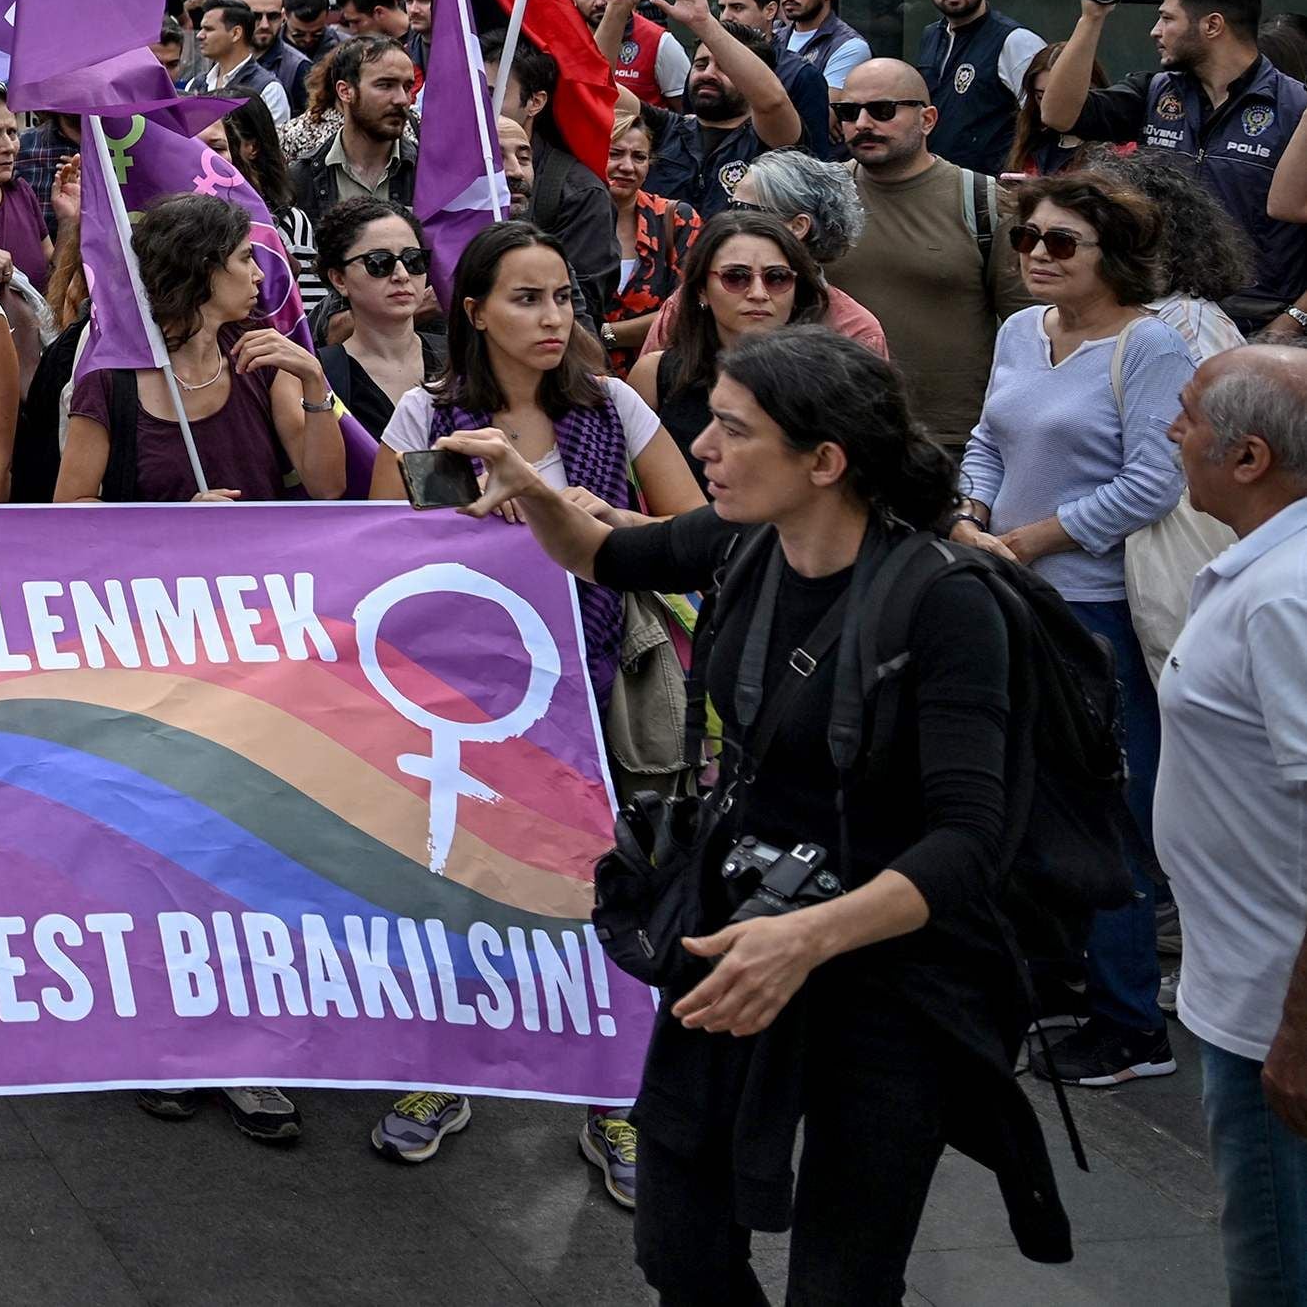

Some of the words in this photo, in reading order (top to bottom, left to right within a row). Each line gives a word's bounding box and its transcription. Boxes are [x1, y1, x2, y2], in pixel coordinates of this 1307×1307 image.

[1143, 124, 1184, 141] ÜVENLİ
[1226, 141, 1271, 158] POLİS
[156, 911, 619, 1039] BIRAKILSIN!
